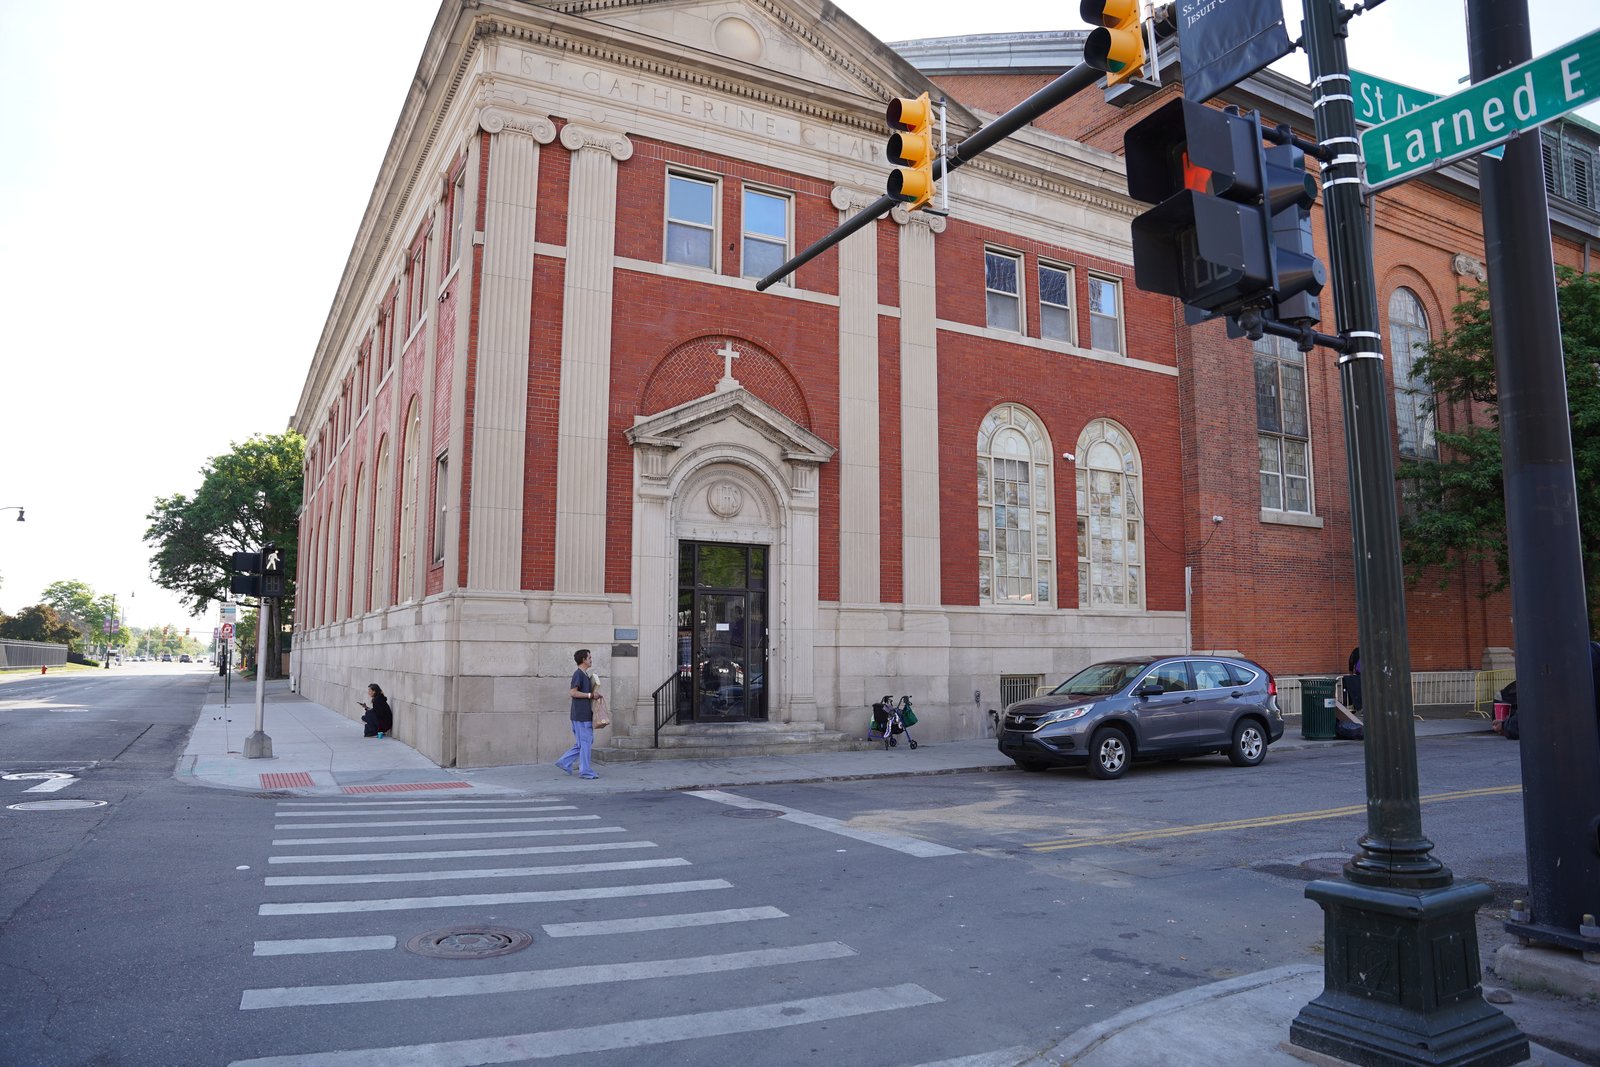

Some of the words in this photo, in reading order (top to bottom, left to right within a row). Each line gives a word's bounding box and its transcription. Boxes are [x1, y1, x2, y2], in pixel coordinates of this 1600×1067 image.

[1187, 1, 1217, 28] JESUIT
[582, 71, 776, 135] CATHERINE
[801, 127, 879, 162] CHAP
[1360, 82, 1386, 122] St
[1383, 71, 1538, 171] Larned
[1560, 53, 1585, 102] E
